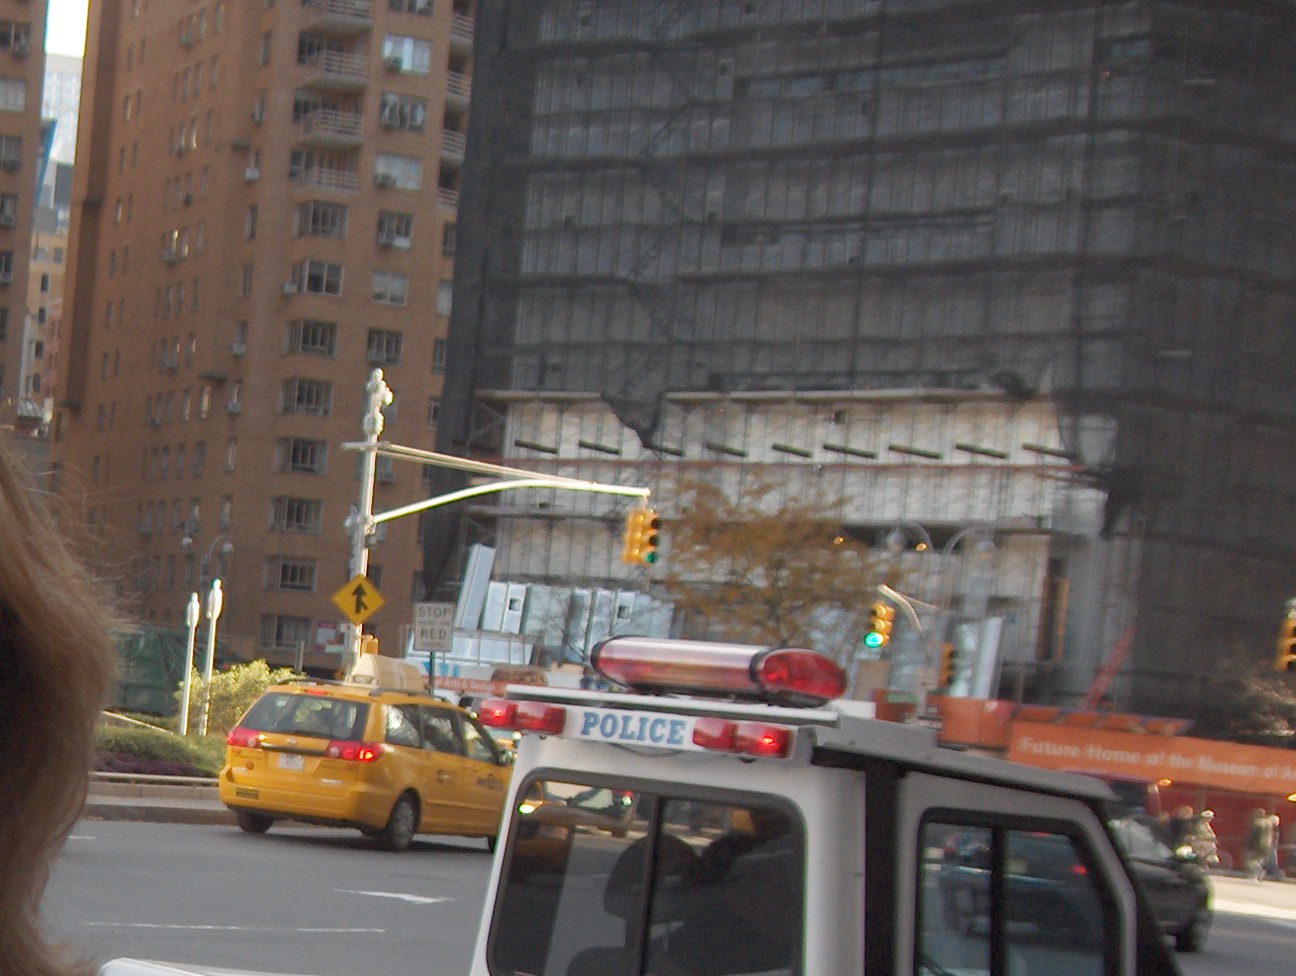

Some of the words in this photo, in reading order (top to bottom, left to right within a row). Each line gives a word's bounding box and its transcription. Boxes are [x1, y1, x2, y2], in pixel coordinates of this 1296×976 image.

[418, 606, 451, 618] STOP
[420, 628, 446, 640] RED
[581, 712, 686, 745] POLICE
[1018, 736, 1080, 758] Future
[1087, 743, 1141, 764] Home
[1147, 752, 1163, 766] of
[1169, 753, 1194, 769] the
[1198, 756, 1260, 777] Museum
[1264, 764, 1279, 779] of
